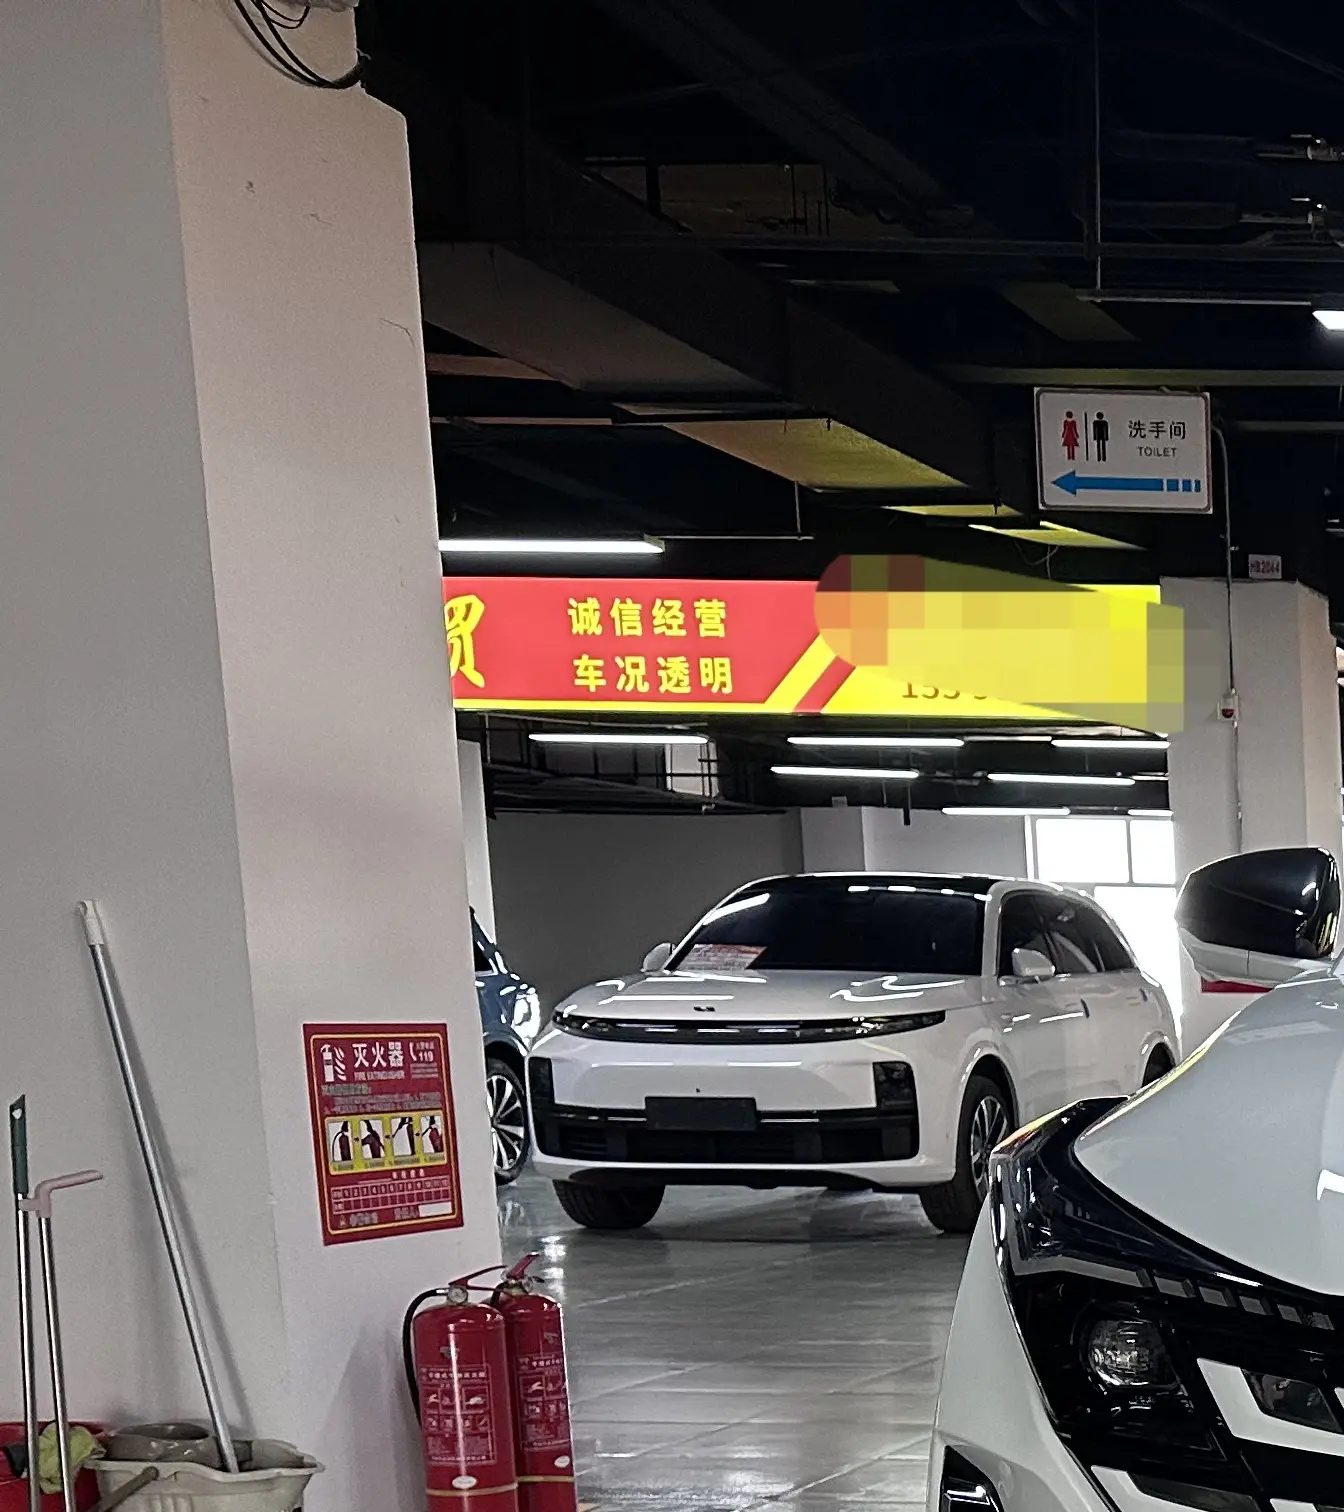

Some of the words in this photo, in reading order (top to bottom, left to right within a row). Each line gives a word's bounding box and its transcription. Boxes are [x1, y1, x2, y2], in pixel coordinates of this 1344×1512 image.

[1127, 420, 1187, 440] 洗手间
[1136, 446, 1177, 458] TOILET
[567, 597, 727, 638] 诚信经营
[573, 654, 733, 694] 车况透明
[352, 1041, 404, 1068] 灭火器
